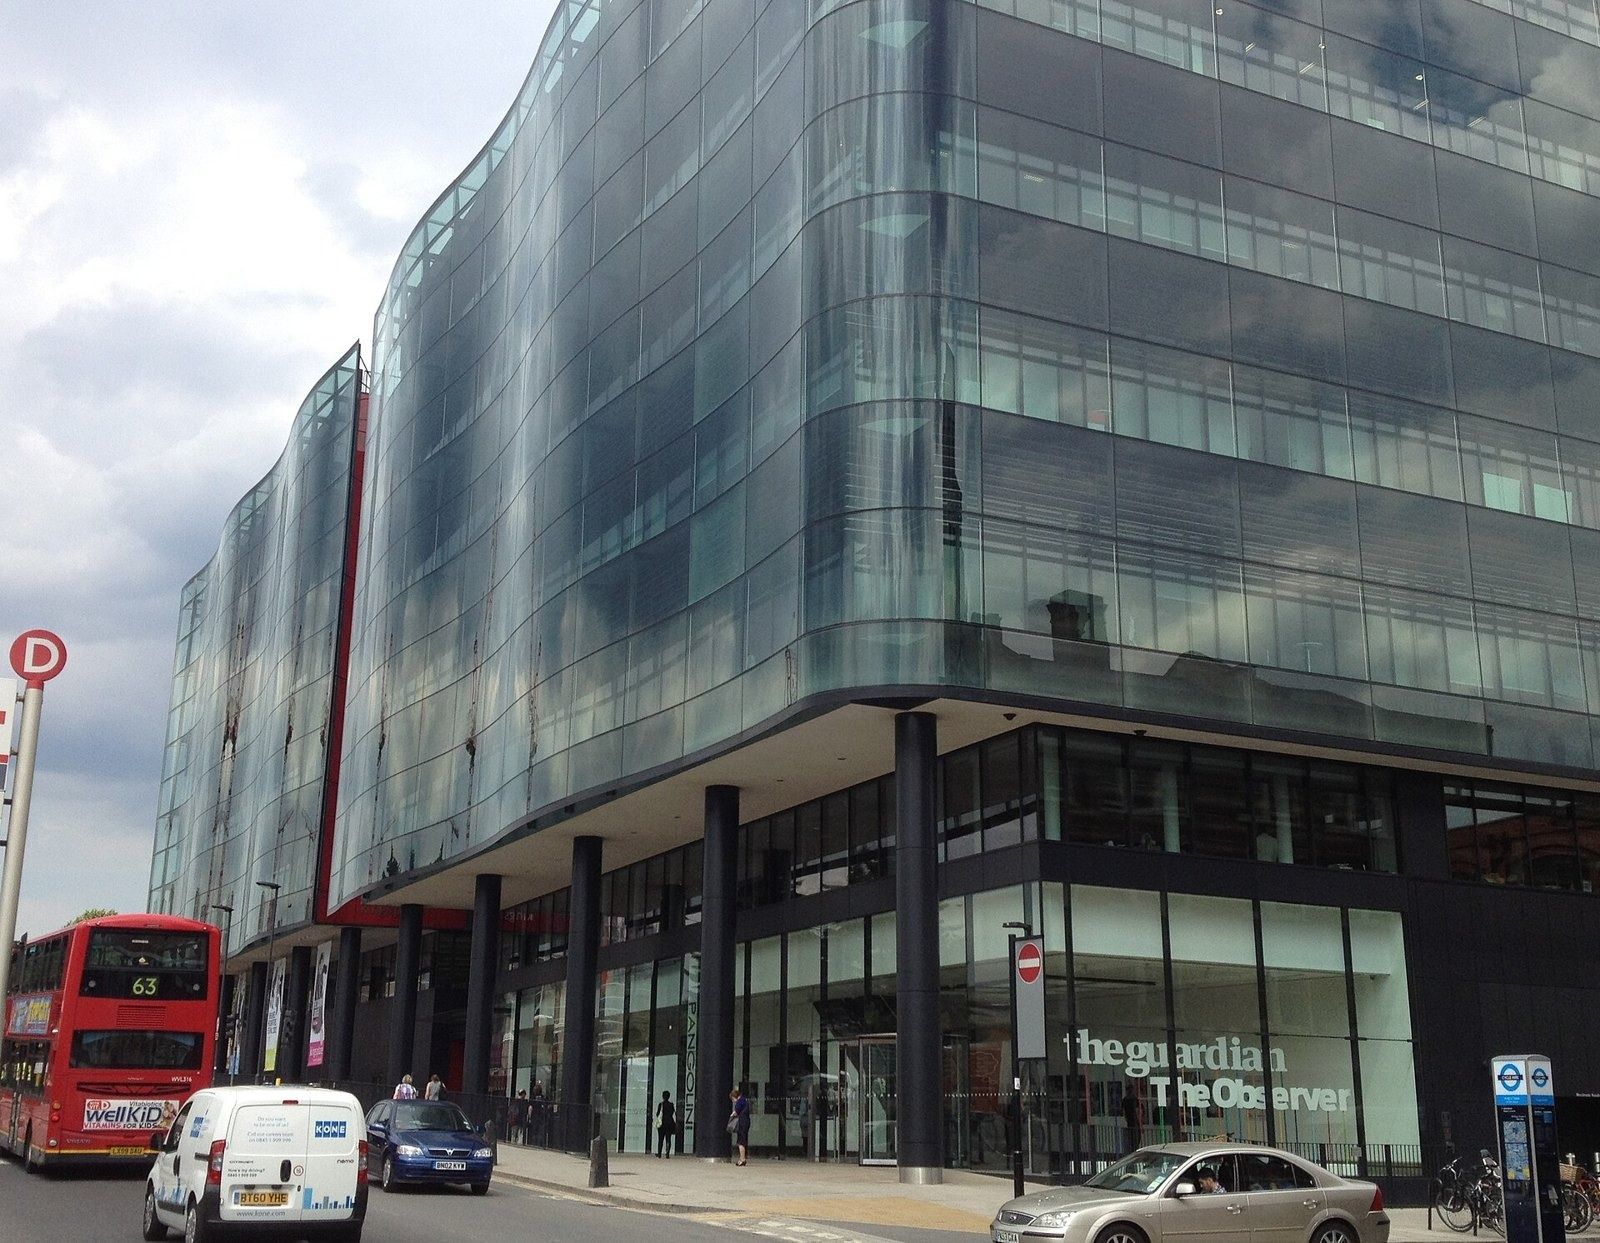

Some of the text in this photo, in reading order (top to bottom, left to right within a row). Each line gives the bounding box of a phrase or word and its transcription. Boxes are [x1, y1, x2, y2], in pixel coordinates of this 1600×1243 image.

[24, 637, 59, 673] D
[132, 978, 157, 995] 63
[685, 1002, 697, 1125] PANGOLIN
[1150, 1076, 1351, 1112] The Observer
[315, 1124, 346, 1134] KONE
[240, 1192, 288, 1202] BT60 YHE
